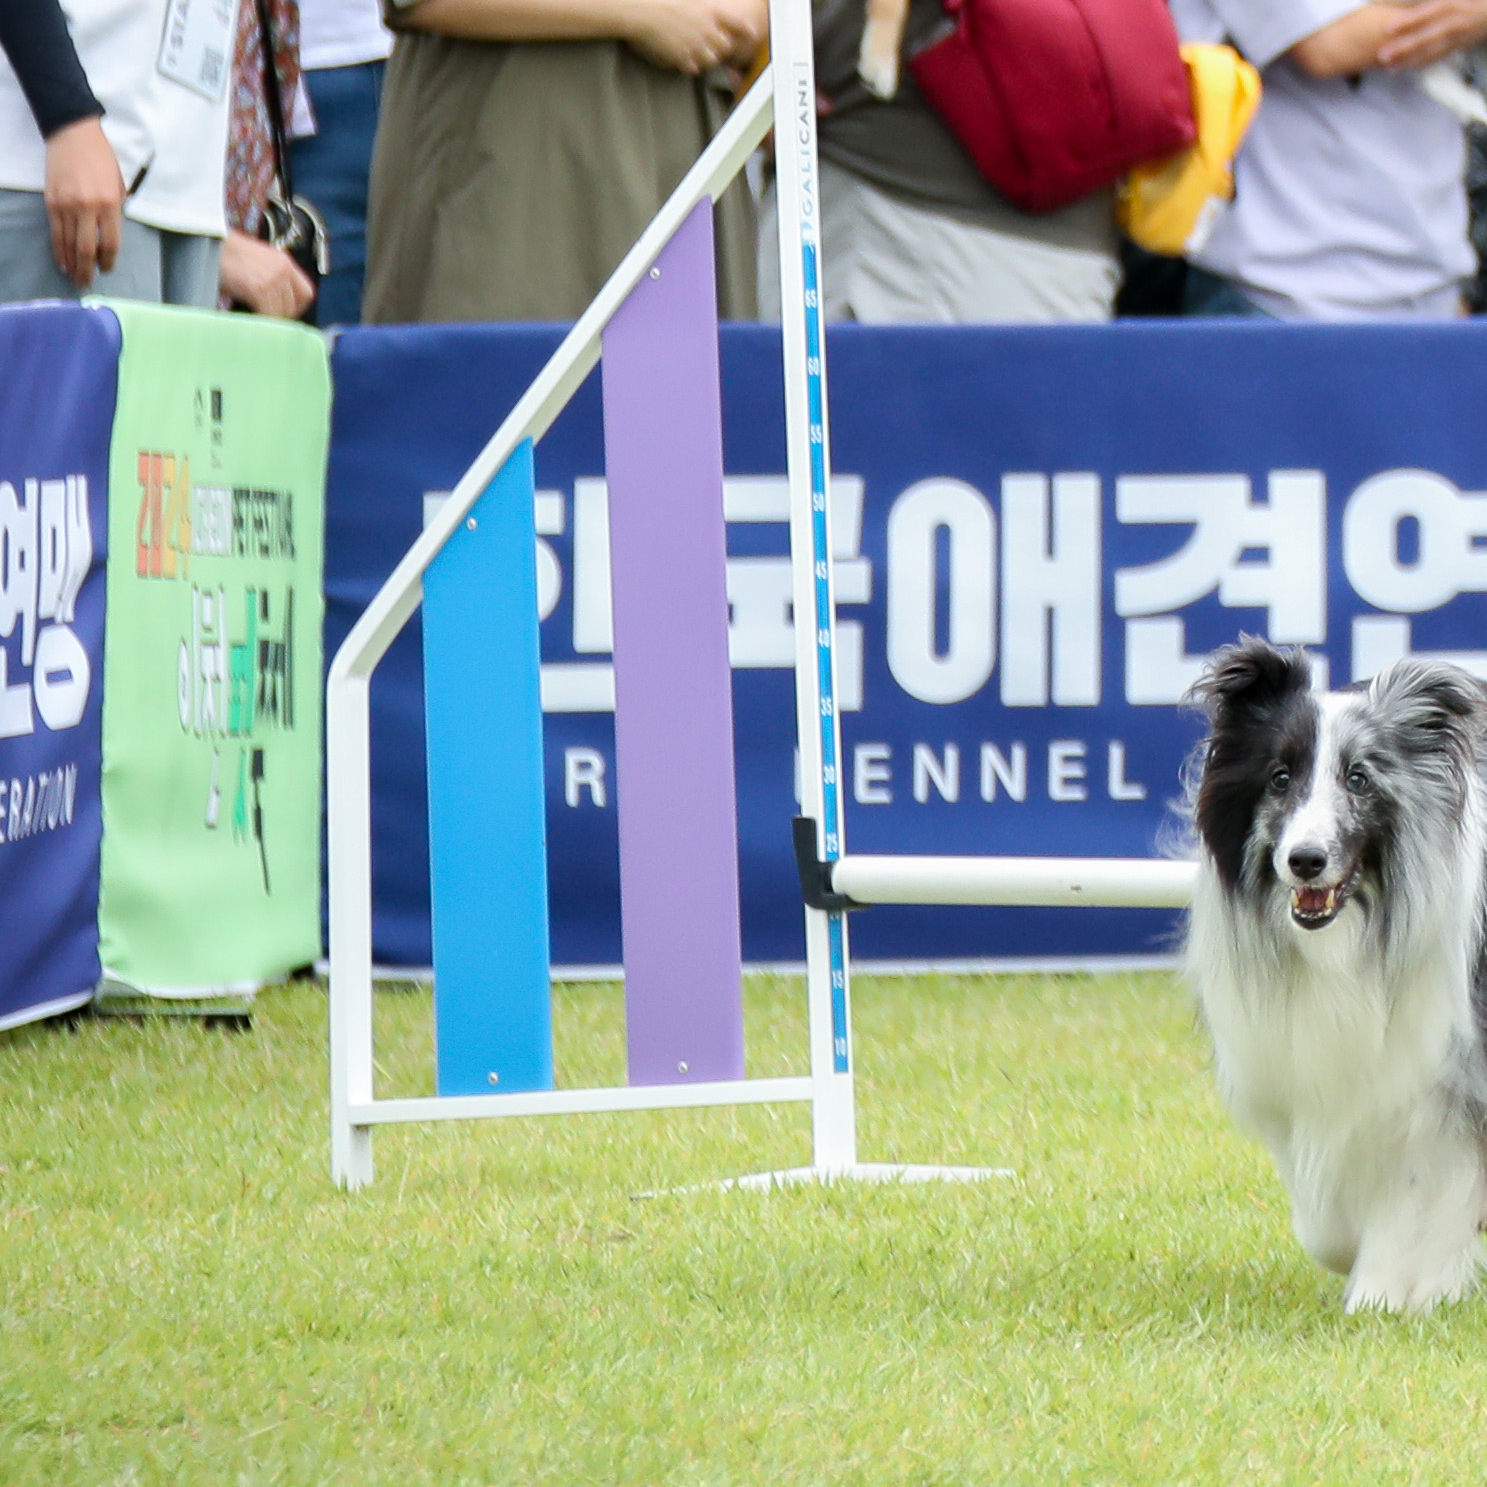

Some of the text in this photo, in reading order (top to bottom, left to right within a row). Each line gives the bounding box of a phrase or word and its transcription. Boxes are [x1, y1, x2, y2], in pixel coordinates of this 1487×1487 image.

[805, 289, 817, 308] 65
[812, 492, 825, 512] 50
[816, 561, 827, 580] 45
[818, 629, 830, 648] 40
[820, 696, 832, 716] 35
[796, 739, 1147, 807] ENNEL
[823, 765, 835, 784] 30
[826, 833, 839, 853] 25
[832, 969, 843, 989] 15
